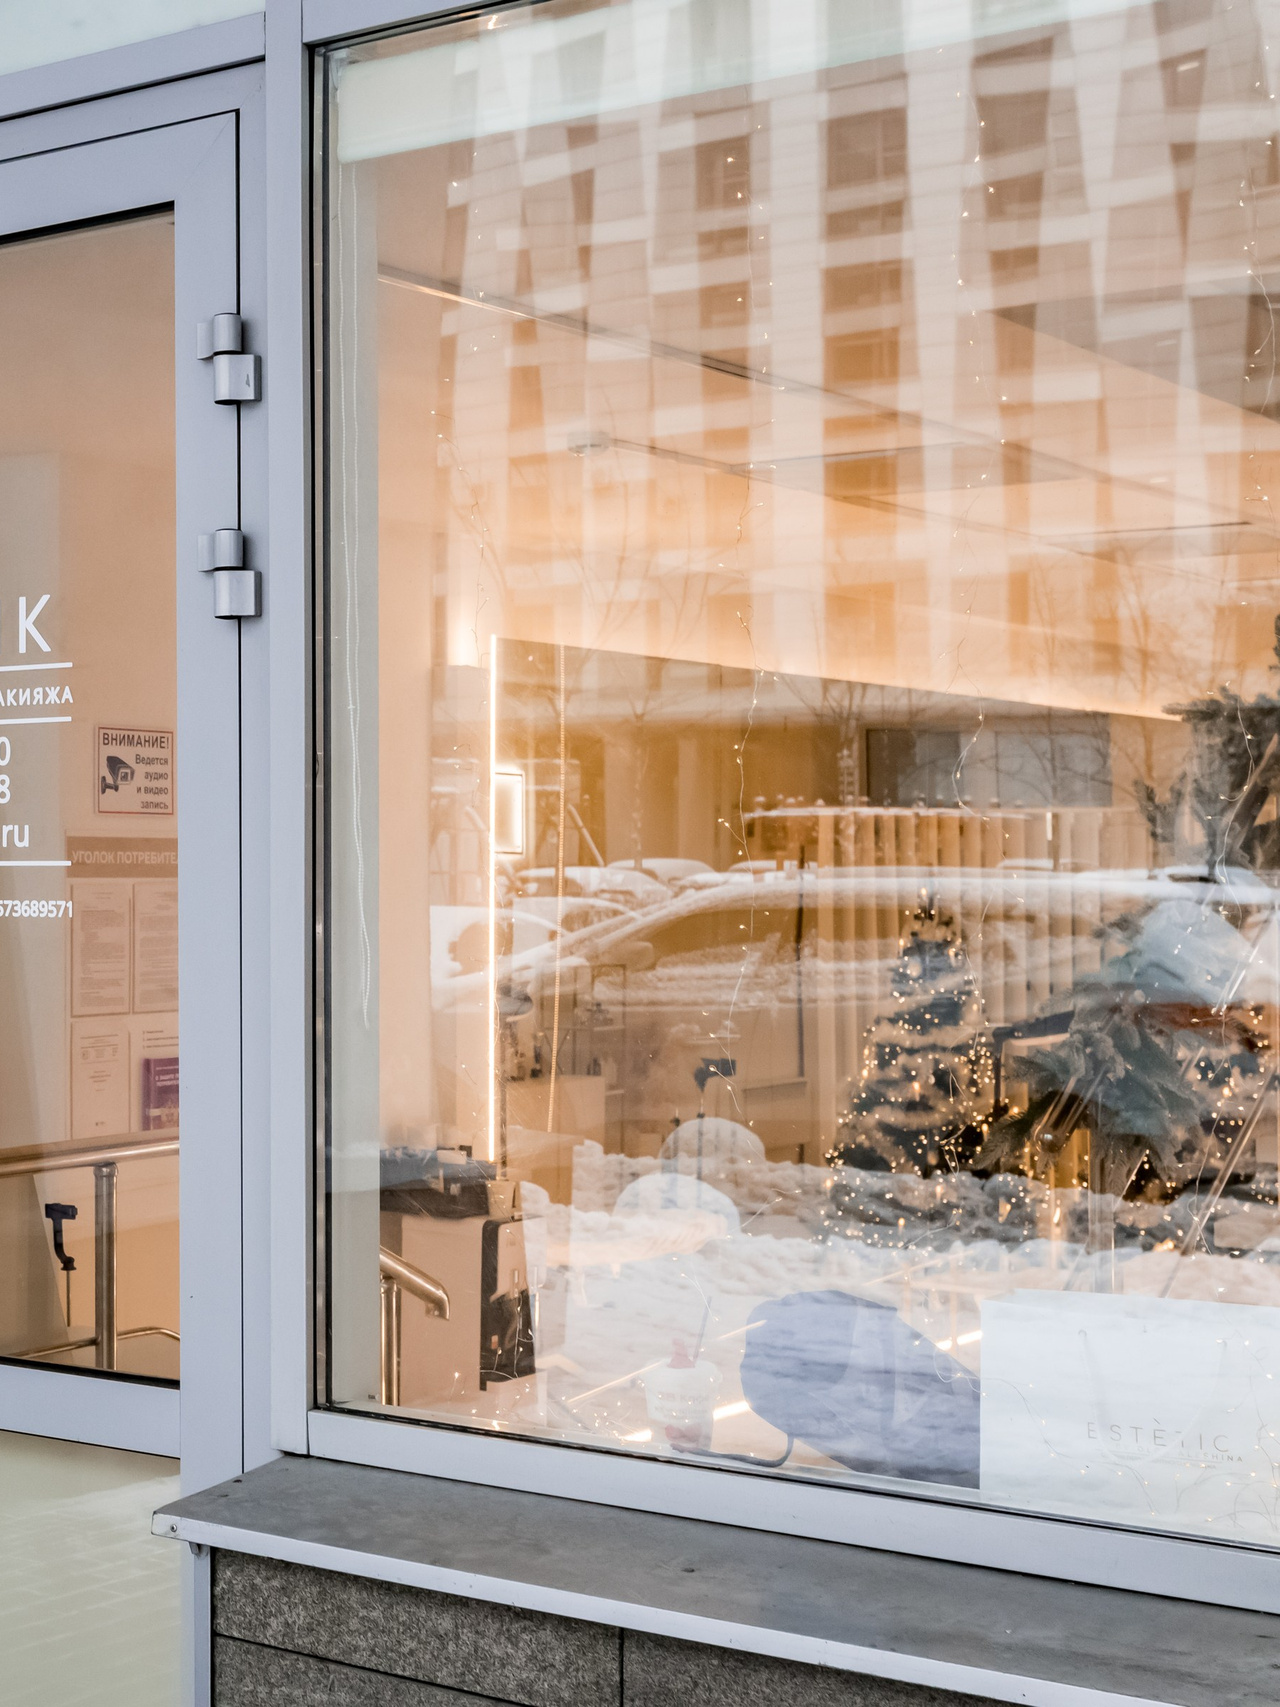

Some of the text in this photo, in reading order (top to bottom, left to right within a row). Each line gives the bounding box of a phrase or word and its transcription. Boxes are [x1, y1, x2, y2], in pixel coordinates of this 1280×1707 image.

[102, 732, 170, 749] ВНИМАНИЕ!
[135, 754, 169, 765] Ведется
[144, 772, 169, 782] аудио
[144, 787, 169, 796] видео
[140, 801, 169, 810] запись
[72, 851, 179, 865] УГОЛОК ПОТРЕБИТЕ
